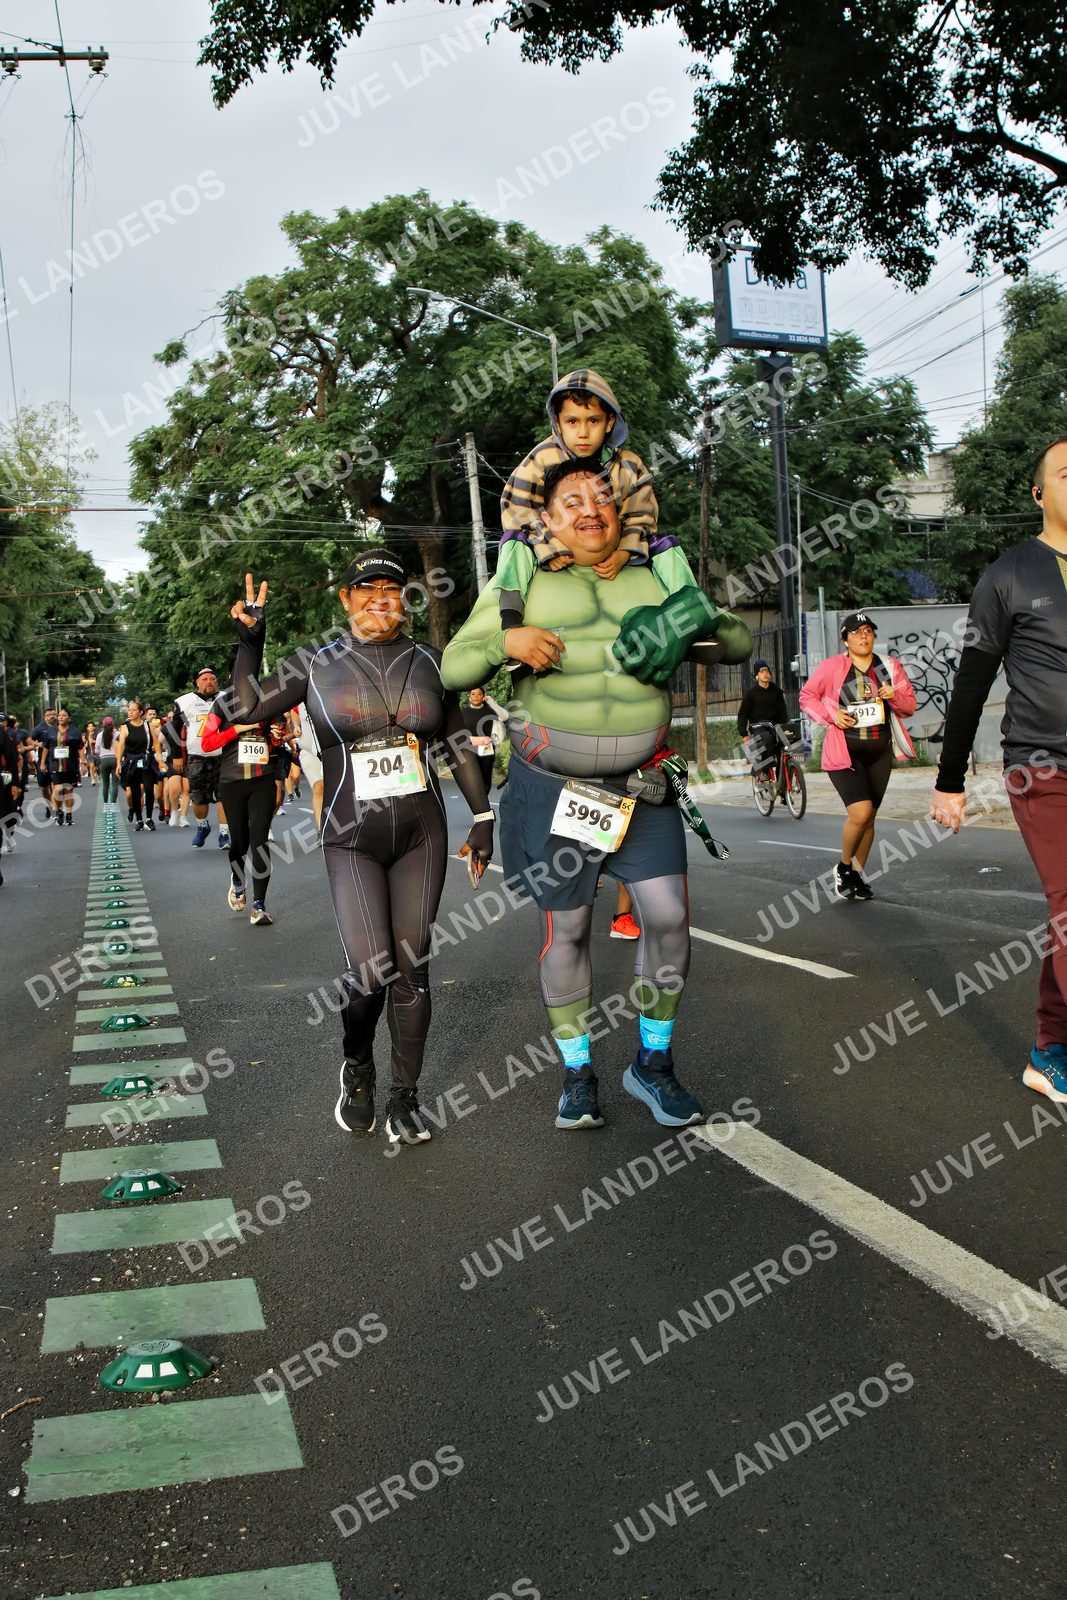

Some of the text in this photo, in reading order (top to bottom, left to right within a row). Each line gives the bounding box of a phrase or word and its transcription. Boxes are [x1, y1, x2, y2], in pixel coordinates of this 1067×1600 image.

[889, 629, 940, 649] TOY
[243, 744, 265, 755] 3160
[367, 754, 404, 778] 204
[565, 800, 613, 831] 5996
